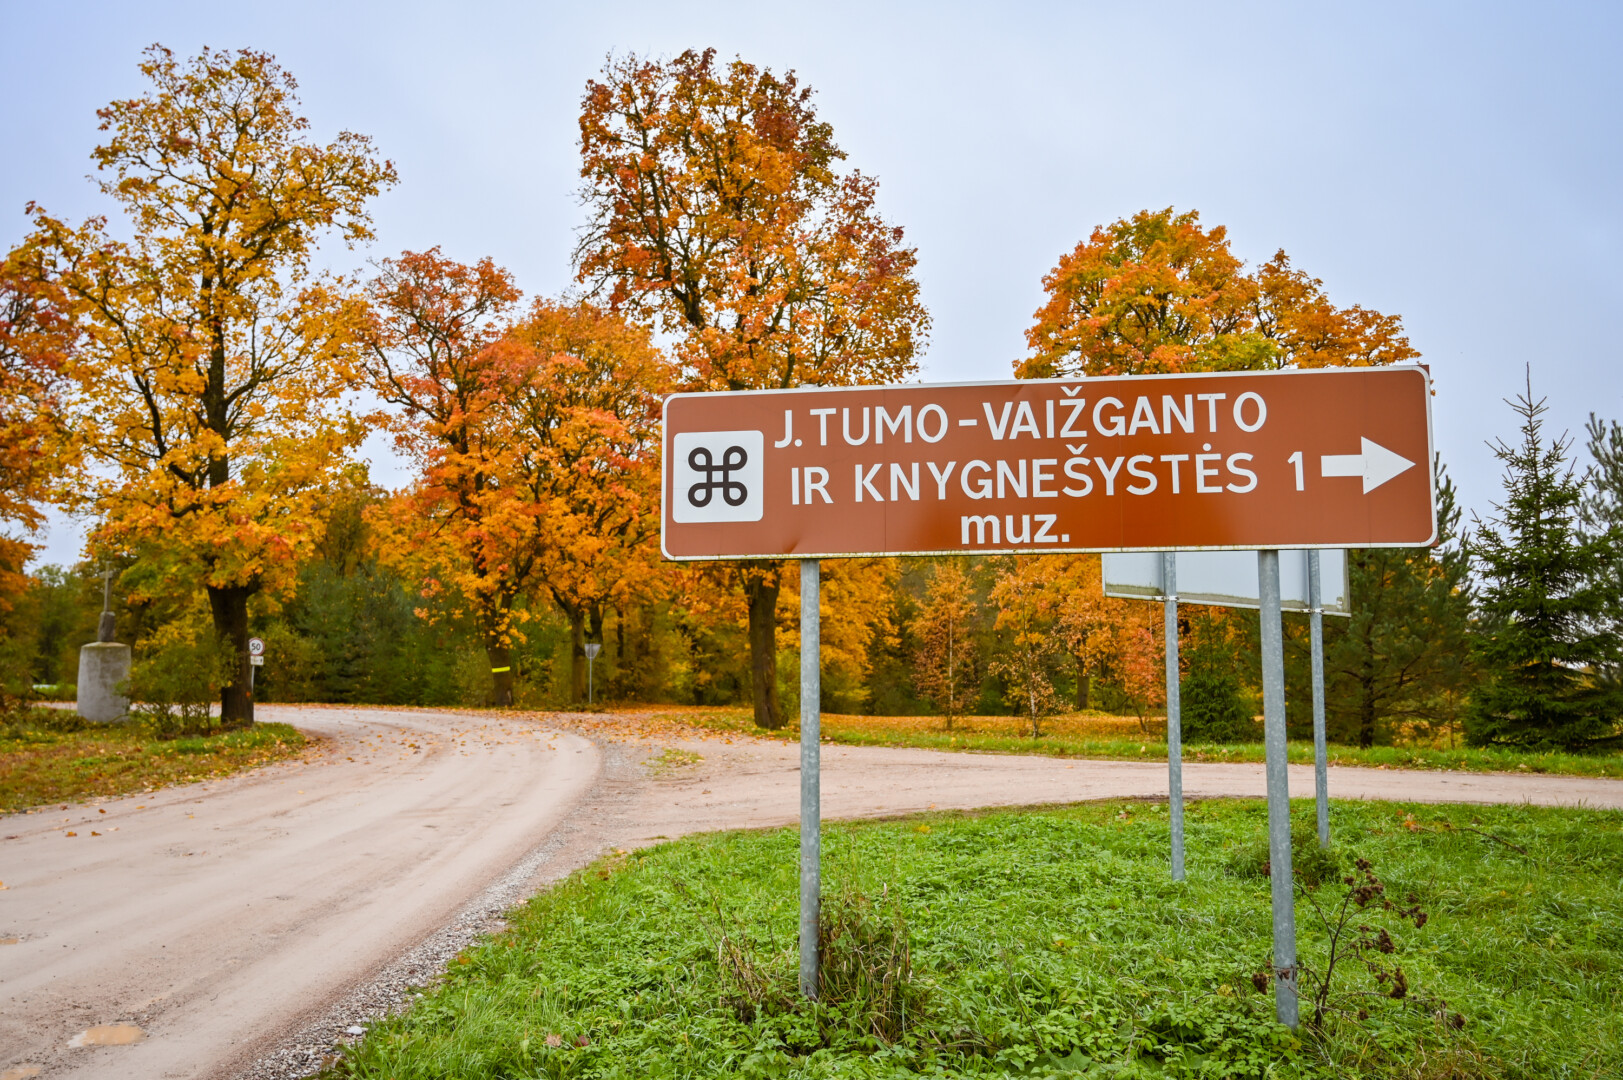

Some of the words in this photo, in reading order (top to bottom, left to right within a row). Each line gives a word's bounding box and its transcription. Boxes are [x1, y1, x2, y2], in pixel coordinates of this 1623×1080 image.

[791, 466, 834, 506] IR
[854, 442, 1258, 505] KNYGNEŠYSTĖS
[1287, 450, 1305, 492] 1
[960, 513, 1070, 545] muz.
[251, 642, 261, 651] 50
